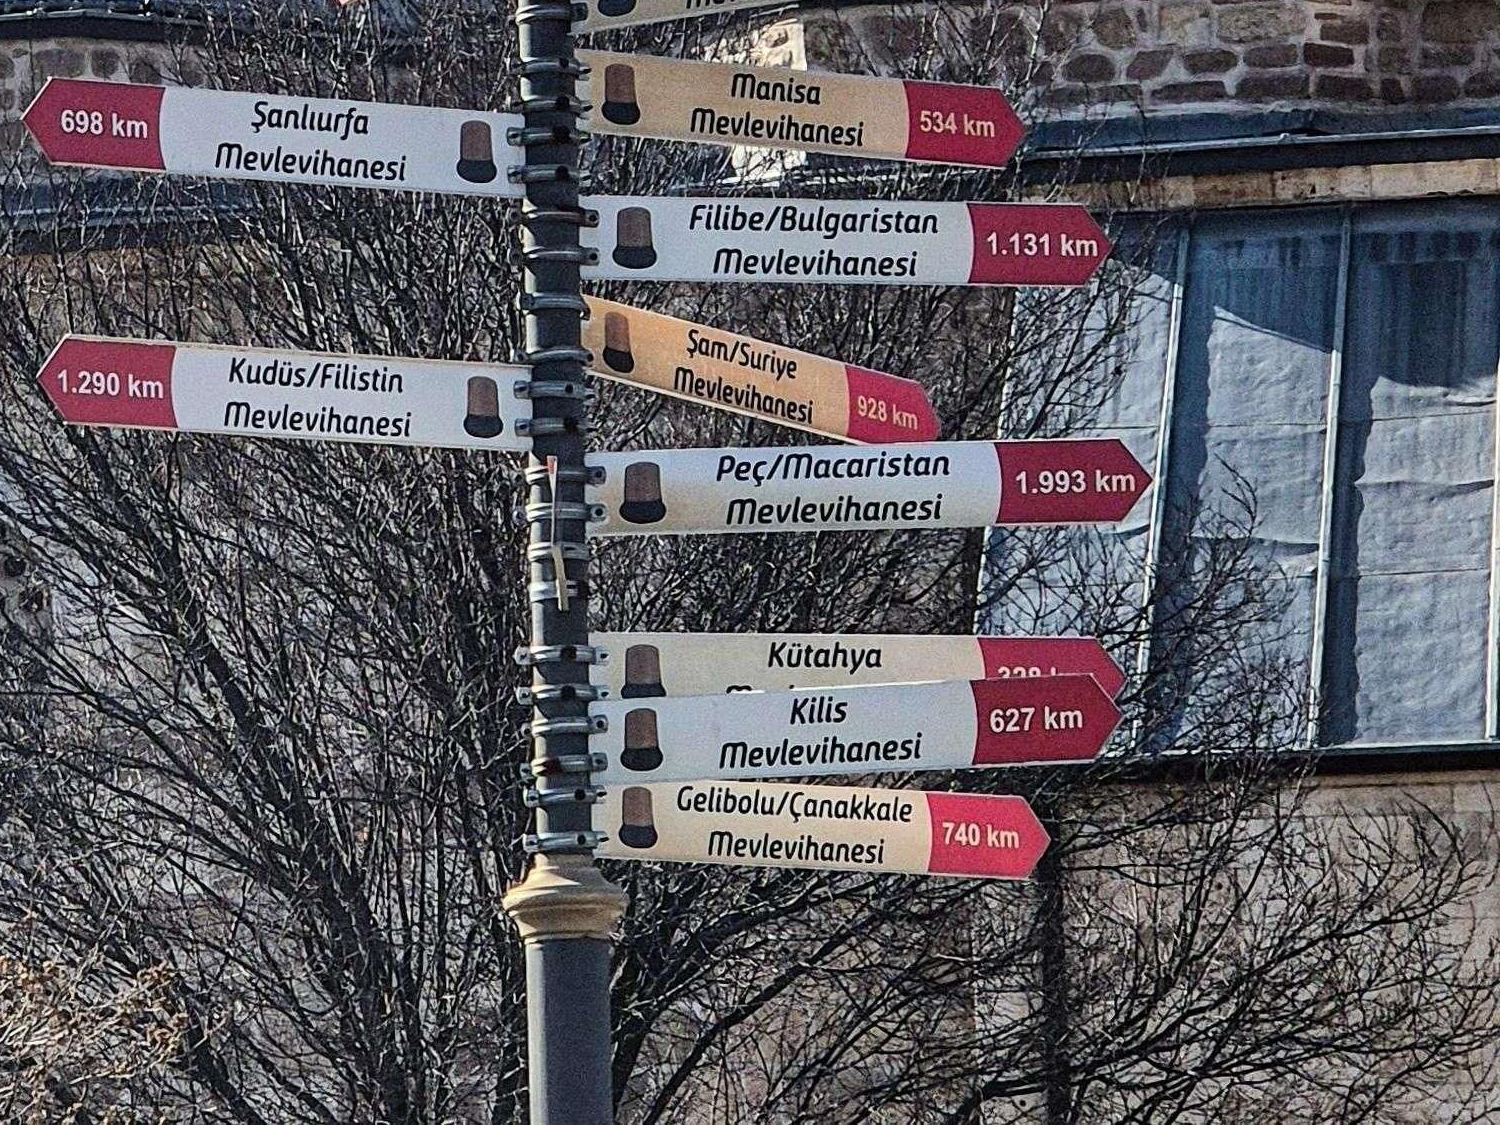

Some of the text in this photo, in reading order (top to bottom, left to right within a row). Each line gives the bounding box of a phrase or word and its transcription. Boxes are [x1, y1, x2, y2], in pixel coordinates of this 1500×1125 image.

[730, 73, 821, 106] Manisa
[60, 109, 149, 139] 698 km
[251, 101, 370, 139] Şanlıurfa
[690, 107, 865, 147] Mevlevihanesi
[920, 111, 996, 137] 534 km
[215, 142, 407, 181] Mevlevihanesi
[688, 204, 939, 240] Filibe/Bulgaristan
[713, 248, 918, 277] Mevlevihanesi
[986, 232, 1099, 258] 1.131 km
[686, 328, 798, 381] Şam/Suriye
[56, 371, 164, 399] 1.290 km
[228, 357, 404, 394] Kudüs/Filistin
[673, 366, 814, 425] Mevlevihanesi
[857, 395, 919, 430] 928 km
[223, 401, 411, 438] Mevlevihanesi
[715, 453, 950, 488] Peç/Macaristan
[1015, 470, 1136, 495] 1.993 km
[726, 493, 943, 525] Mevlevihanesi
[767, 641, 883, 675] Kütahya
[789, 695, 848, 725] Kilis
[989, 705, 1083, 733] 627 km
[718, 732, 922, 770] Mevlevihanesi
[676, 784, 913, 824] Gelibolu/Çanakkale
[706, 830, 884, 865] Mevlevihanesi
[941, 821, 1019, 849] 740 km
